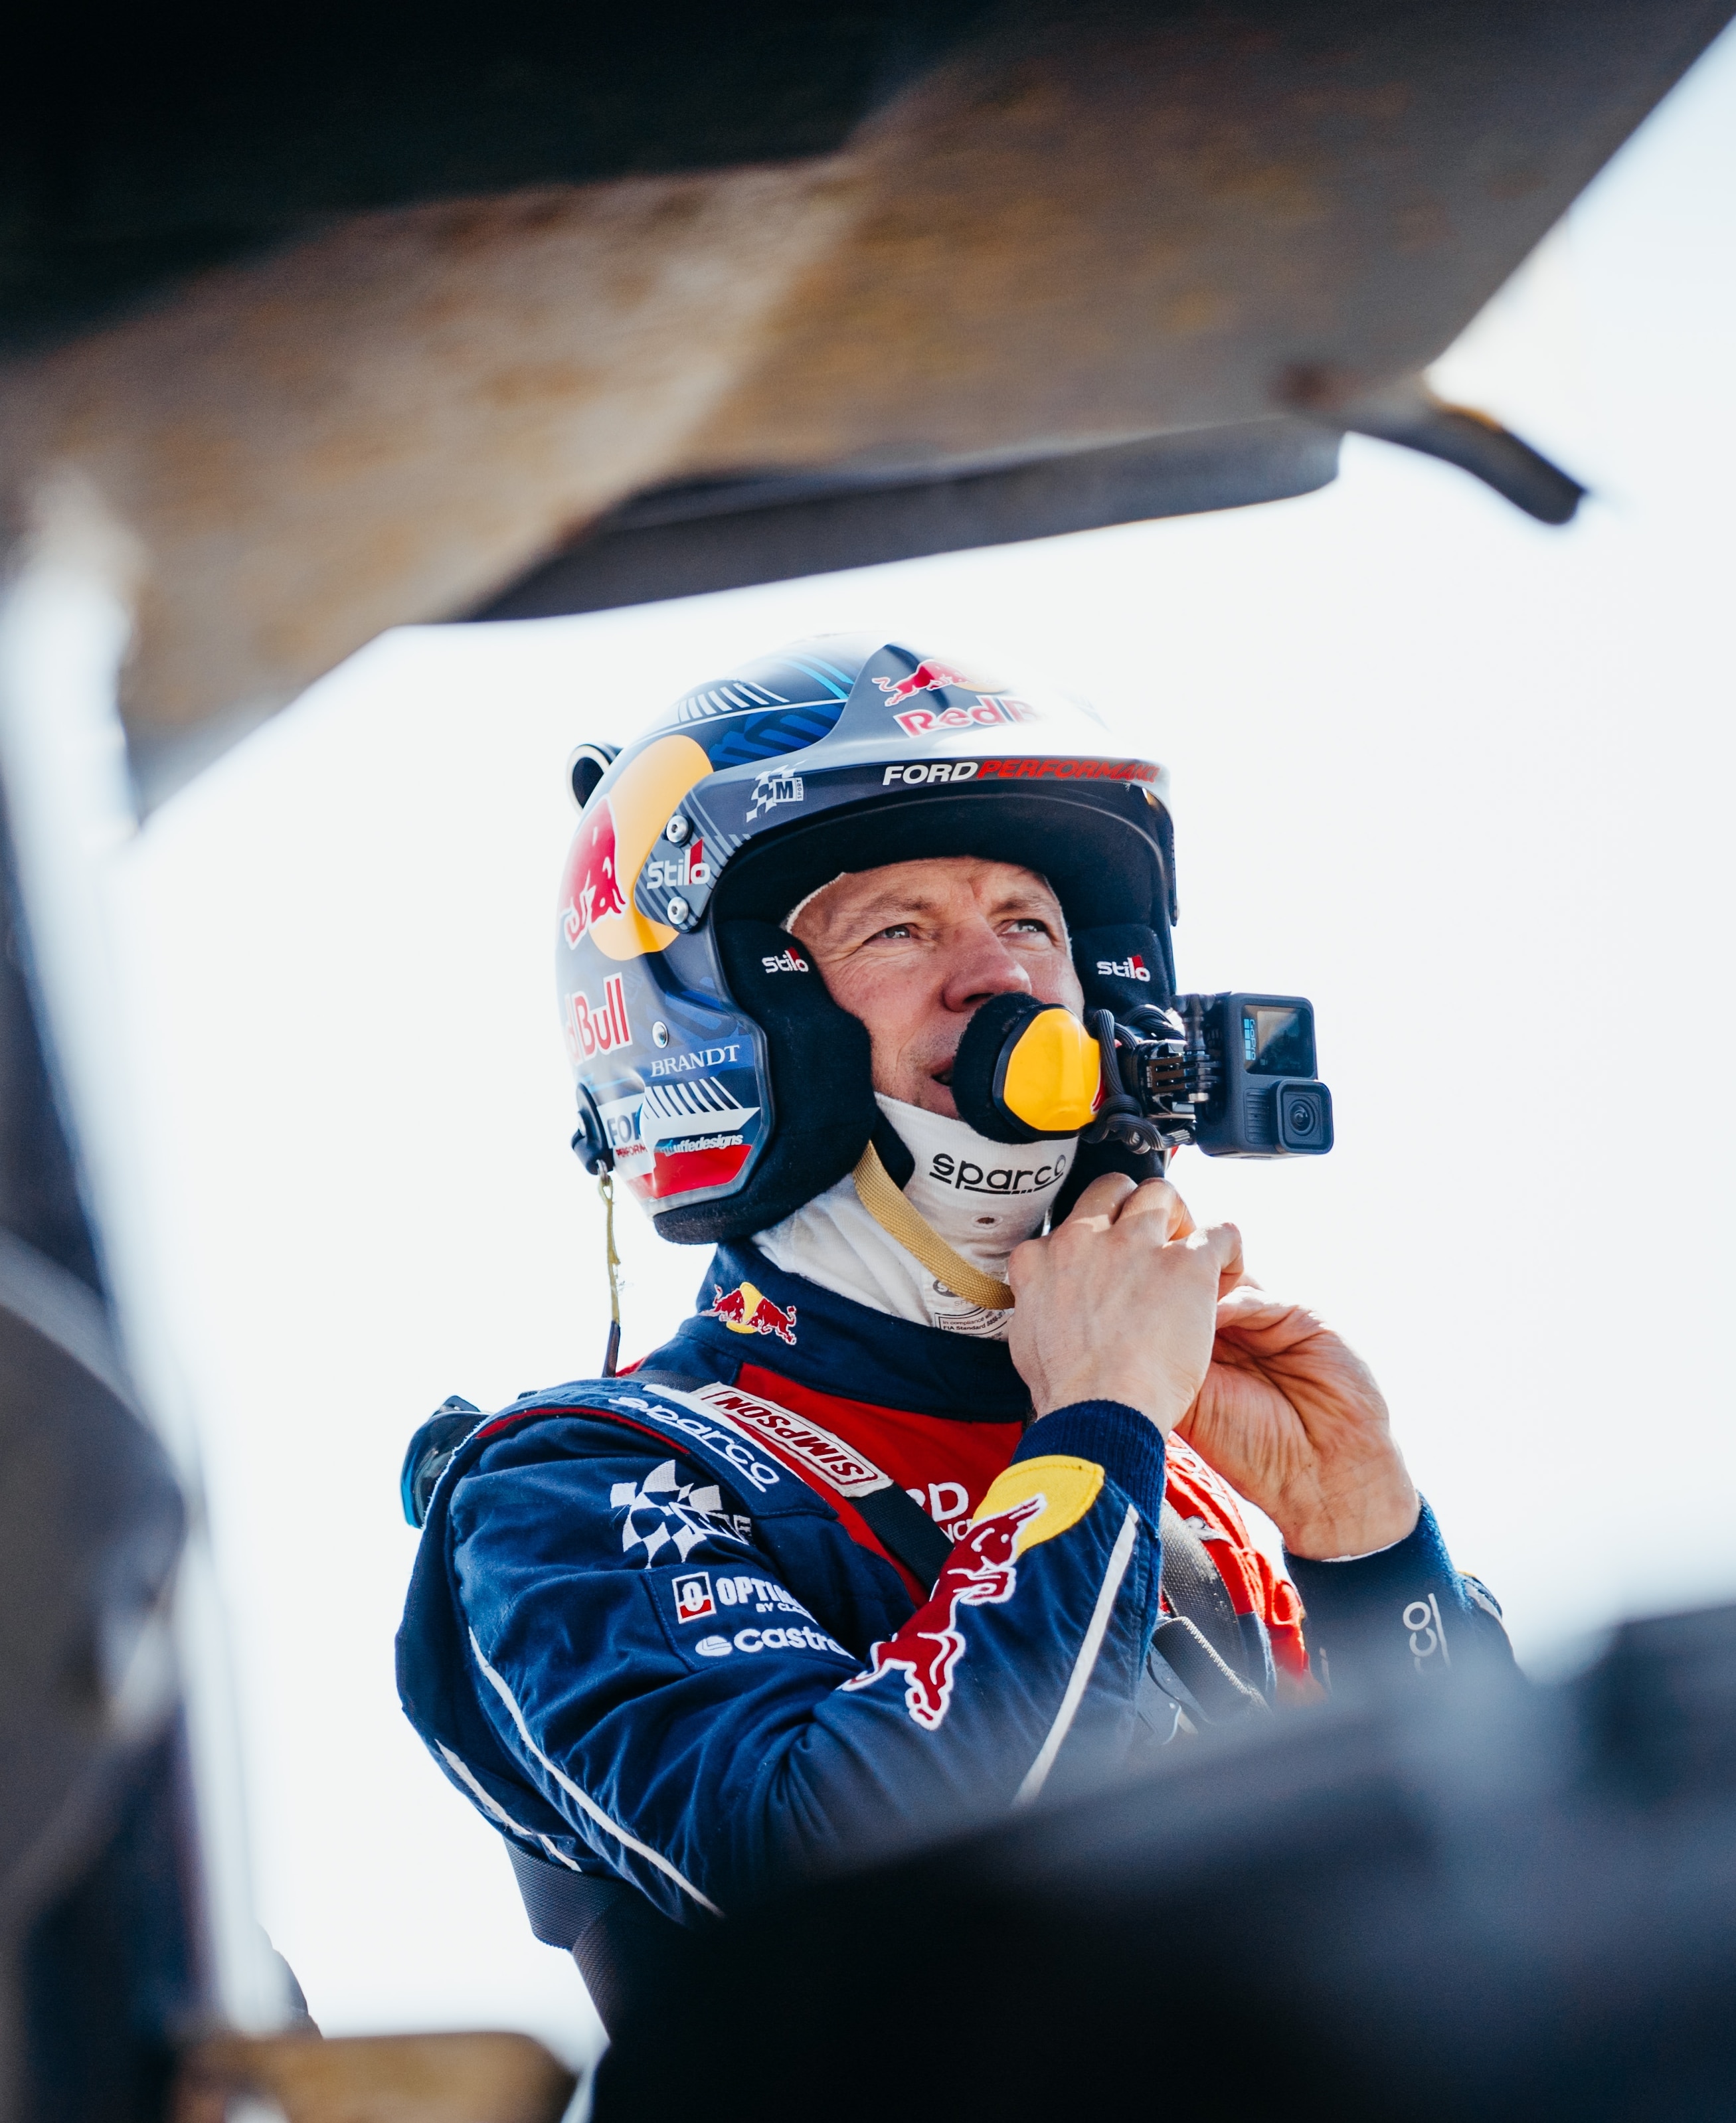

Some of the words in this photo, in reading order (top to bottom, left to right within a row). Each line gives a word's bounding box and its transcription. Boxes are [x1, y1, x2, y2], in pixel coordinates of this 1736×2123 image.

[897, 695, 1007, 738] Red
[775, 780, 794, 800] M
[882, 762, 978, 786] FORD
[573, 976, 630, 1057] Bull
[651, 1044, 740, 1078] BRANDT
[607, 1112, 640, 1146] FO
[930, 1153, 1067, 1193] sparco
[950, 1317, 984, 1325] compliance
[608, 1396, 780, 1486] sparco
[713, 1396, 865, 1476] SIMPSON
[755, 1602, 774, 1613] BY
[733, 1626, 856, 1660] castro
